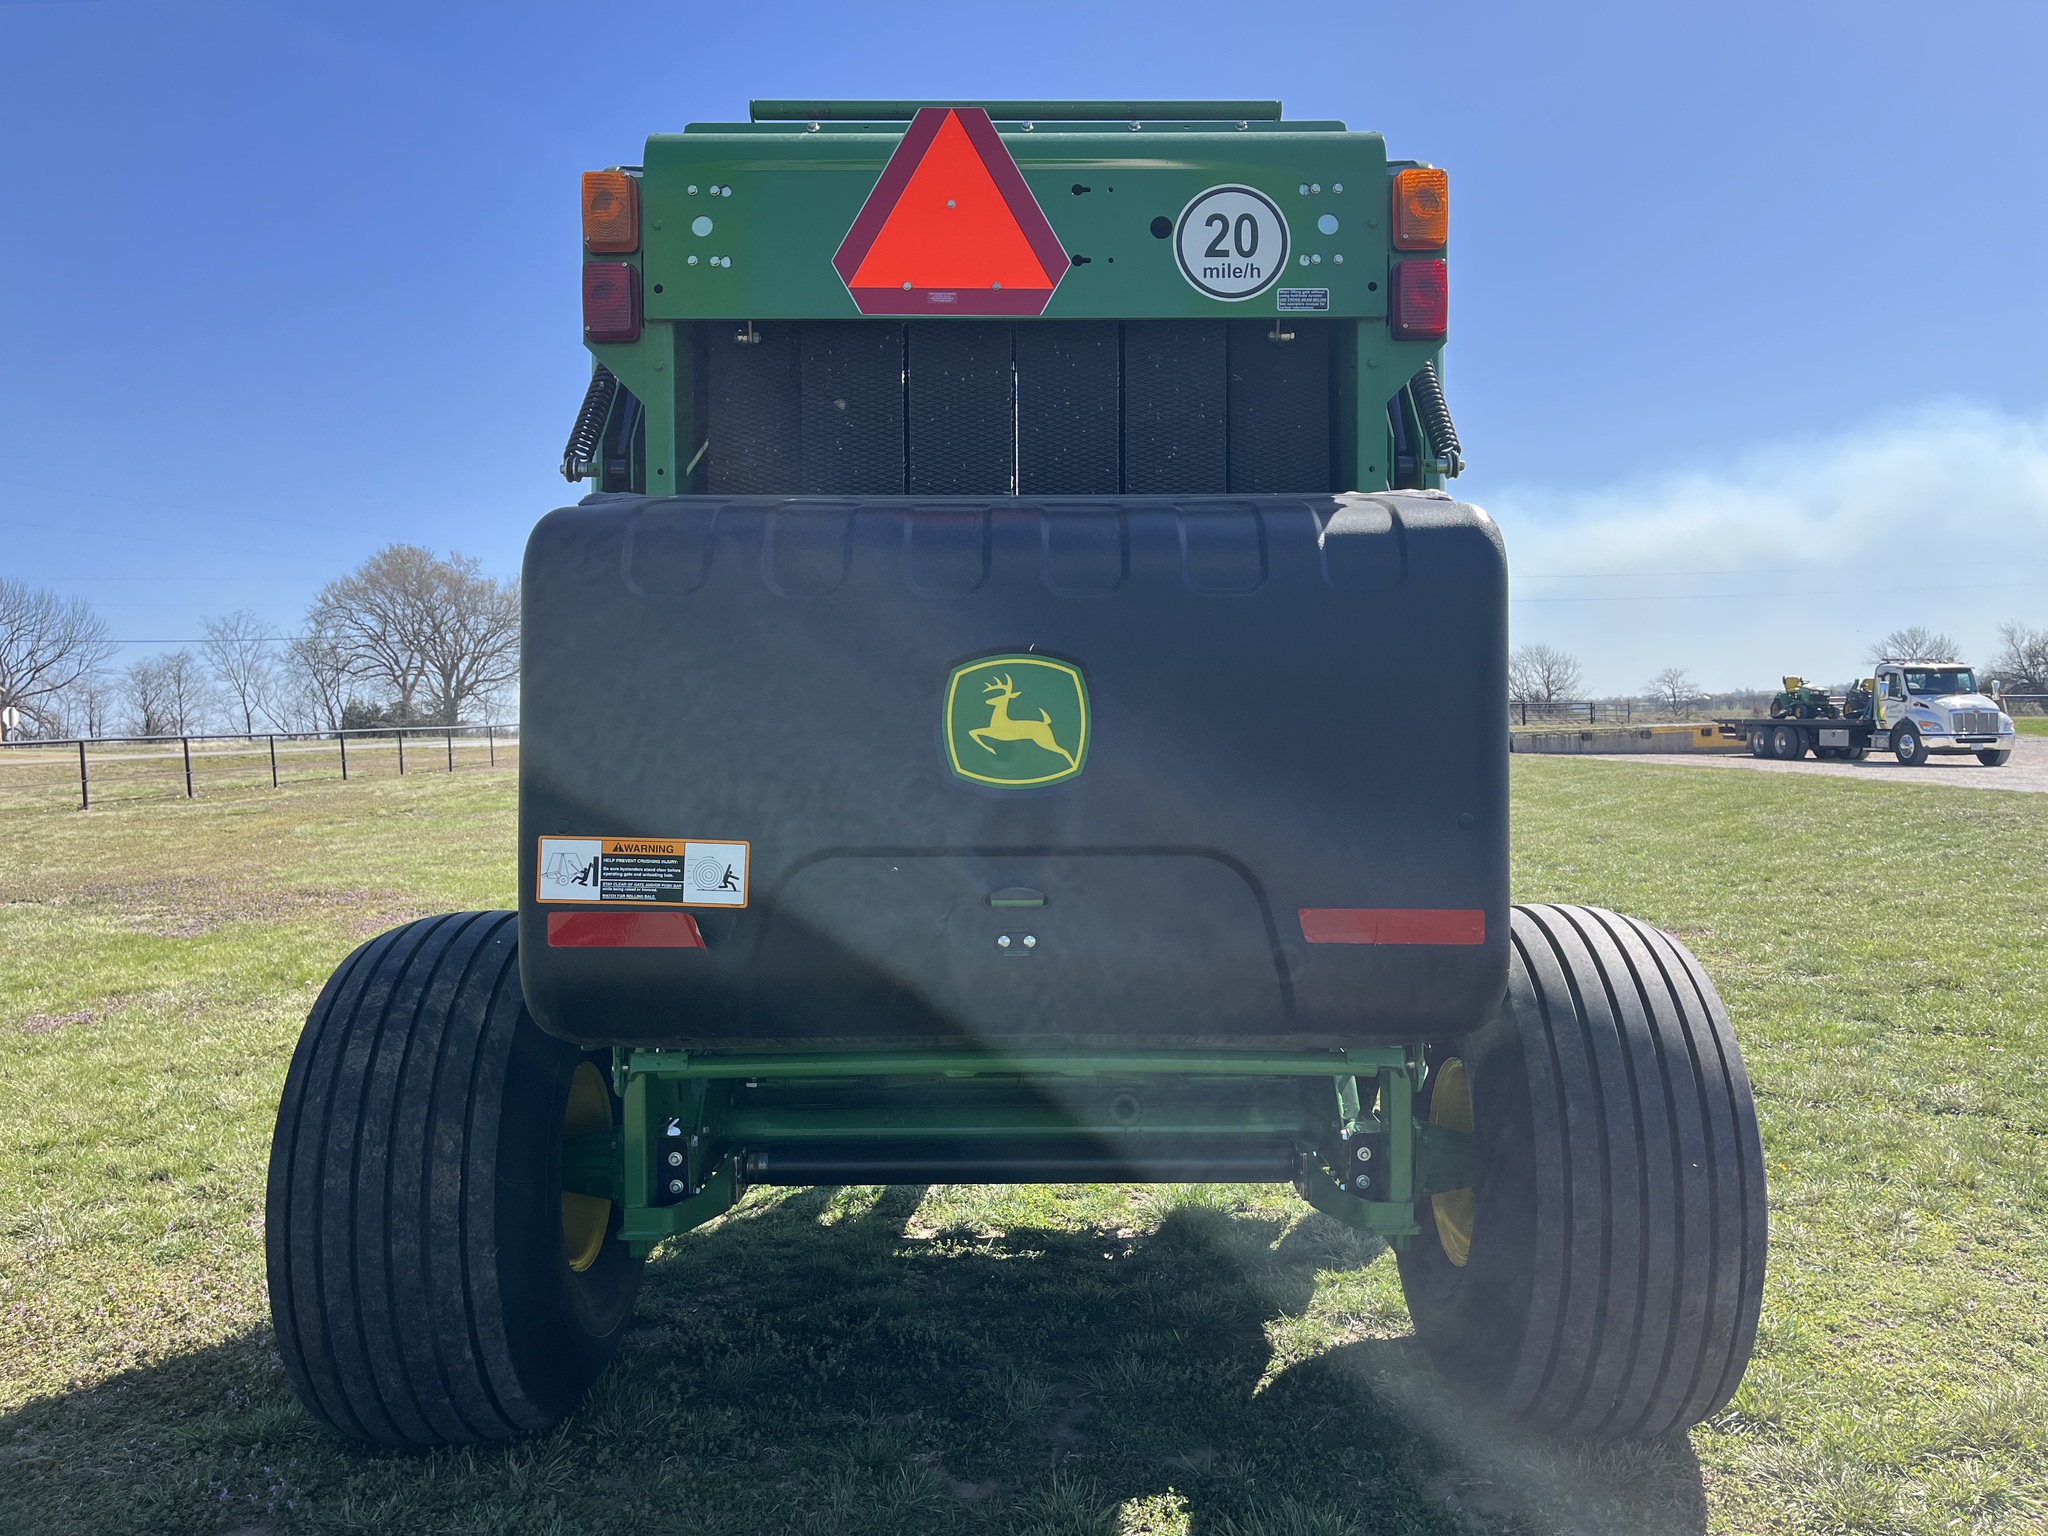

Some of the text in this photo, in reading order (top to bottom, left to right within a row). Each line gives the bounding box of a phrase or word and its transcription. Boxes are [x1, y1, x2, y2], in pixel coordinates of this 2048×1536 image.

[1204, 212, 1259, 258] 20
[1203, 262, 1260, 278] mile/h
[624, 844, 674, 853] WARNING
